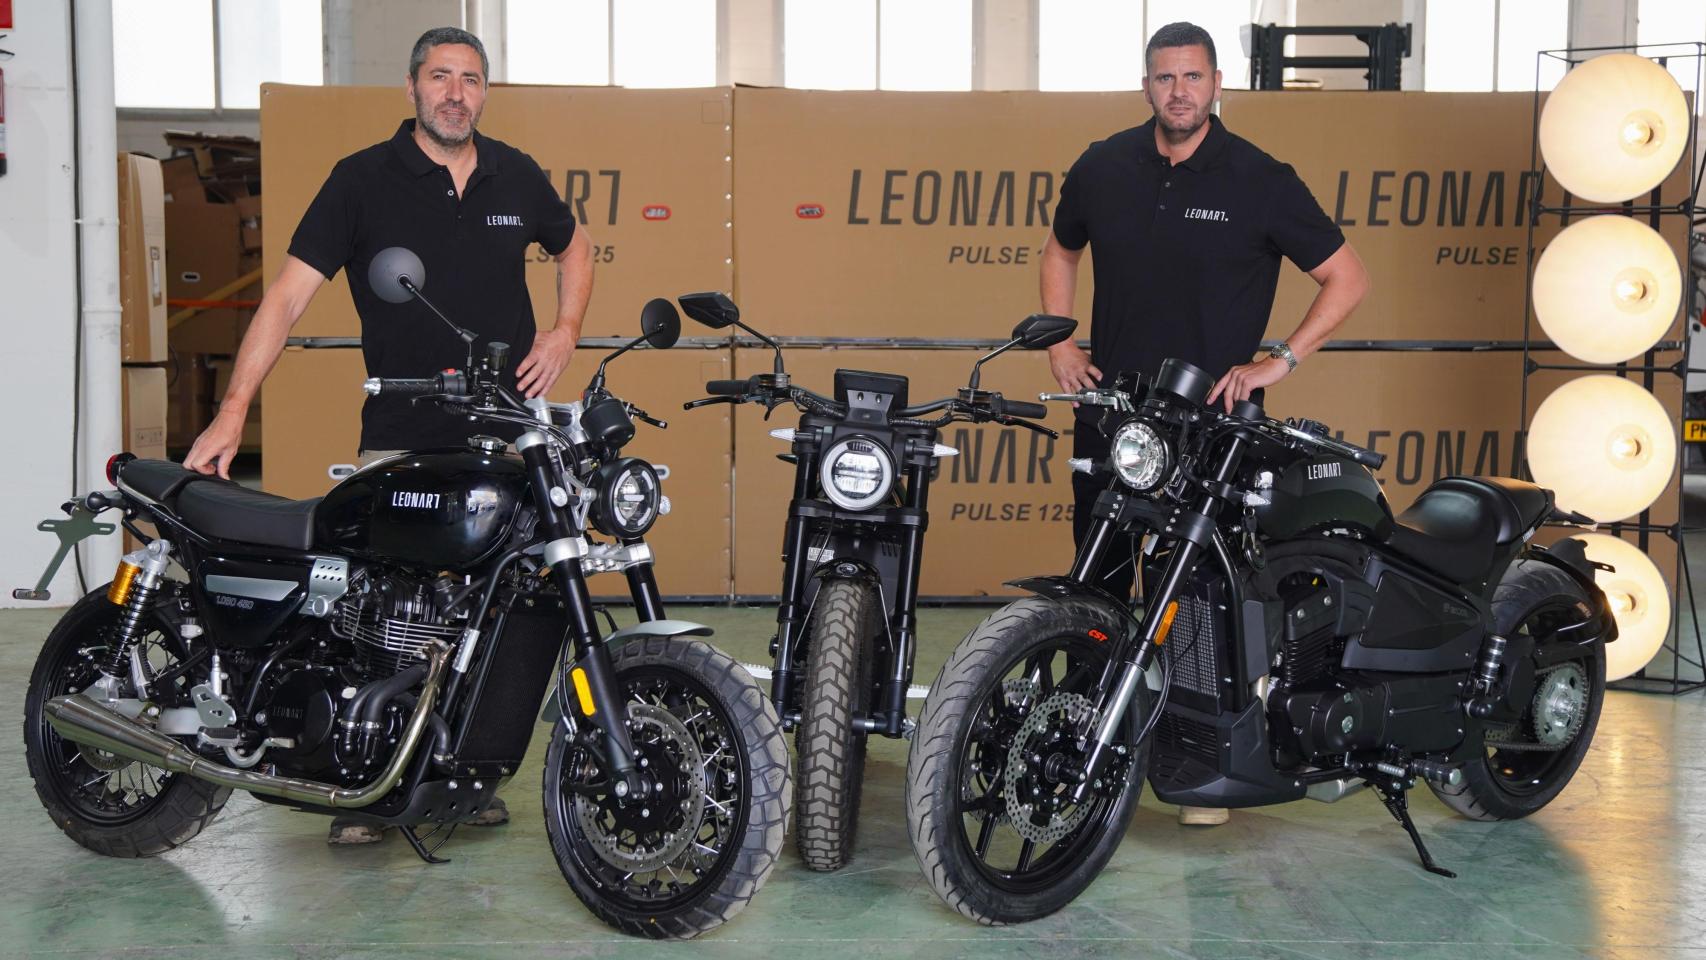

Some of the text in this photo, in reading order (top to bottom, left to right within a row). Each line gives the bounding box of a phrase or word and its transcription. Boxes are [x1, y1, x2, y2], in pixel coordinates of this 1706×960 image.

[848, 169, 1067, 226] LEONAR
[1184, 207, 1229, 222] LEONART.
[594, 246, 615, 263] 25
[949, 246, 1030, 265] PULSE
[1436, 247, 1519, 265] PULSE
[1307, 462, 1342, 480] LEONART
[392, 491, 440, 509] LEONART
[951, 503, 1074, 522] PULSE 125
[1087, 629, 1108, 641] CST
